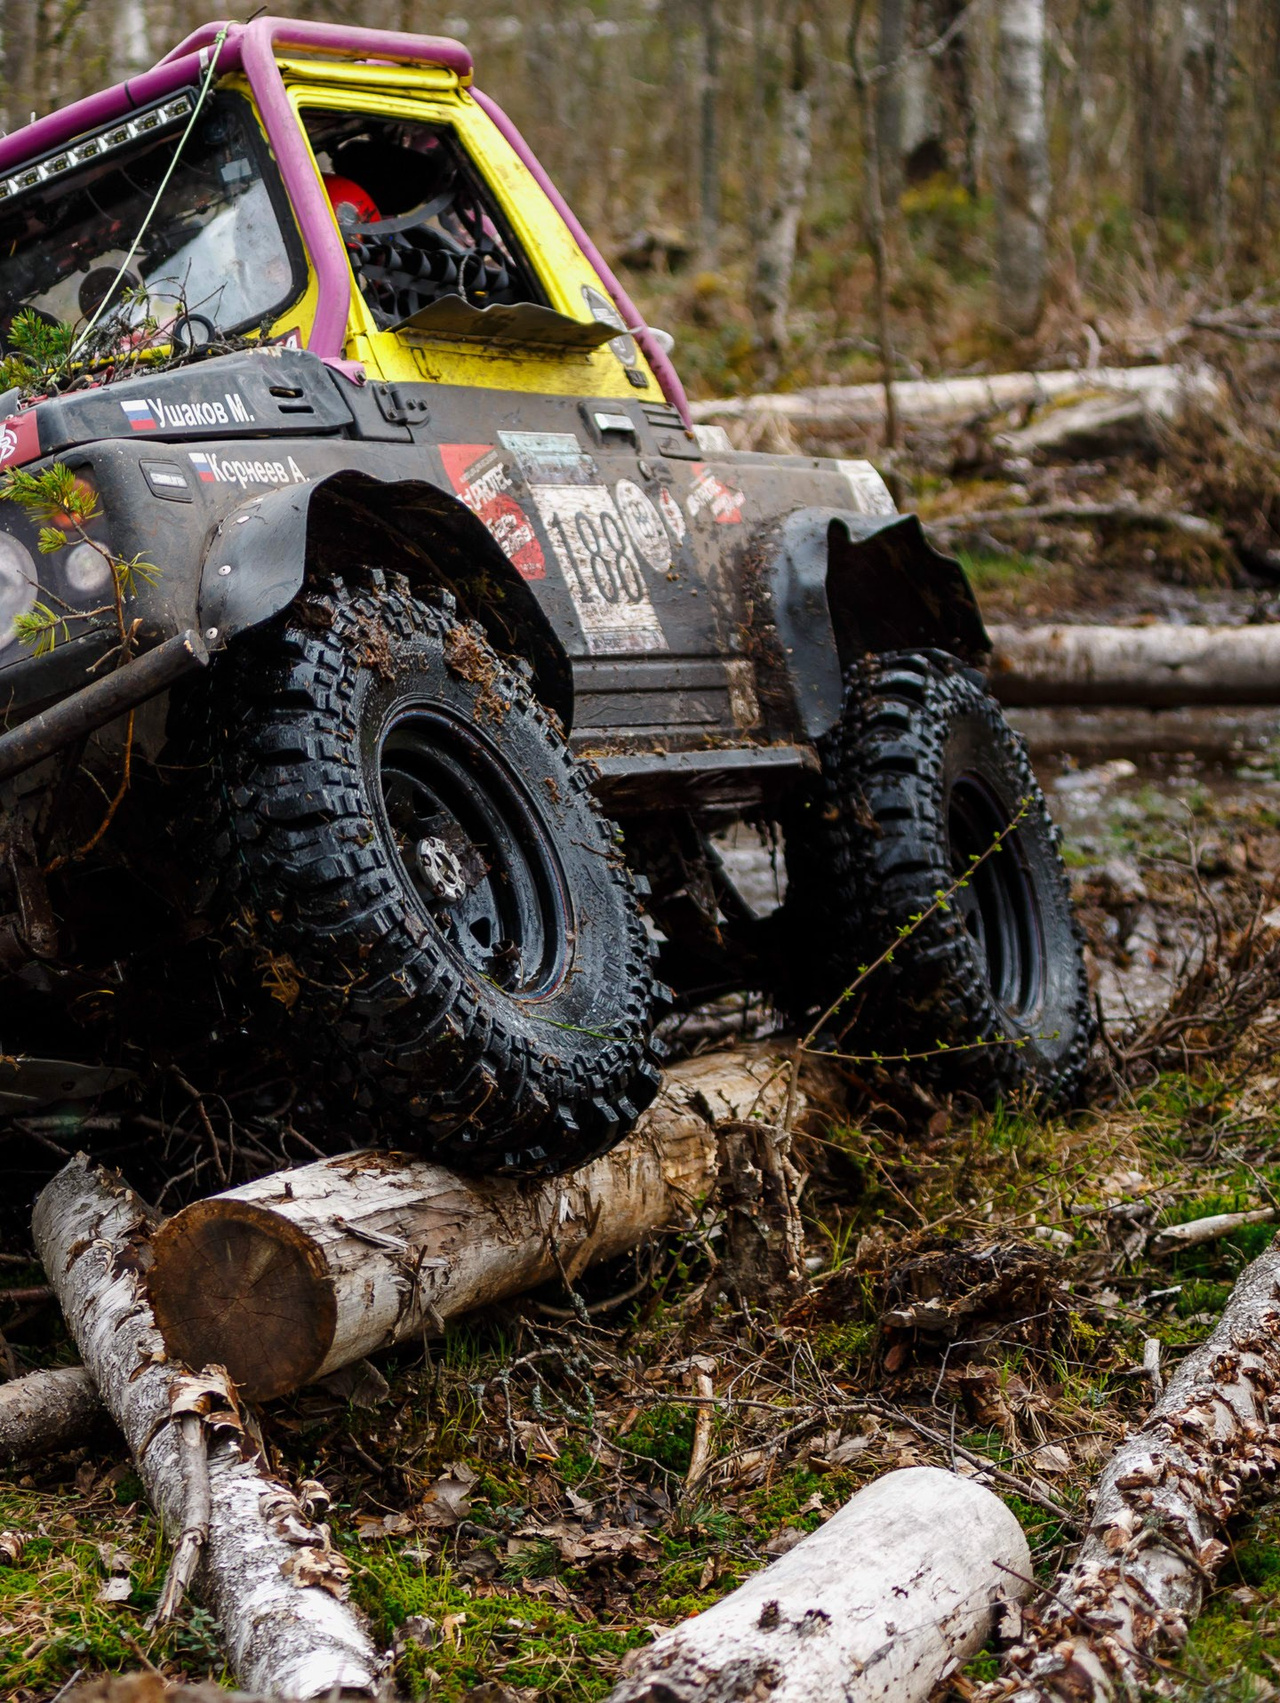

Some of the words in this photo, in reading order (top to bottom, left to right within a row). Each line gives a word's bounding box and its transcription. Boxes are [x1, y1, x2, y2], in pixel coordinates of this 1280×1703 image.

[147, 397, 229, 428] Ушаков
[225, 393, 255, 422] М.
[206, 453, 289, 489] Корнеев
[550, 511, 643, 602] 188
